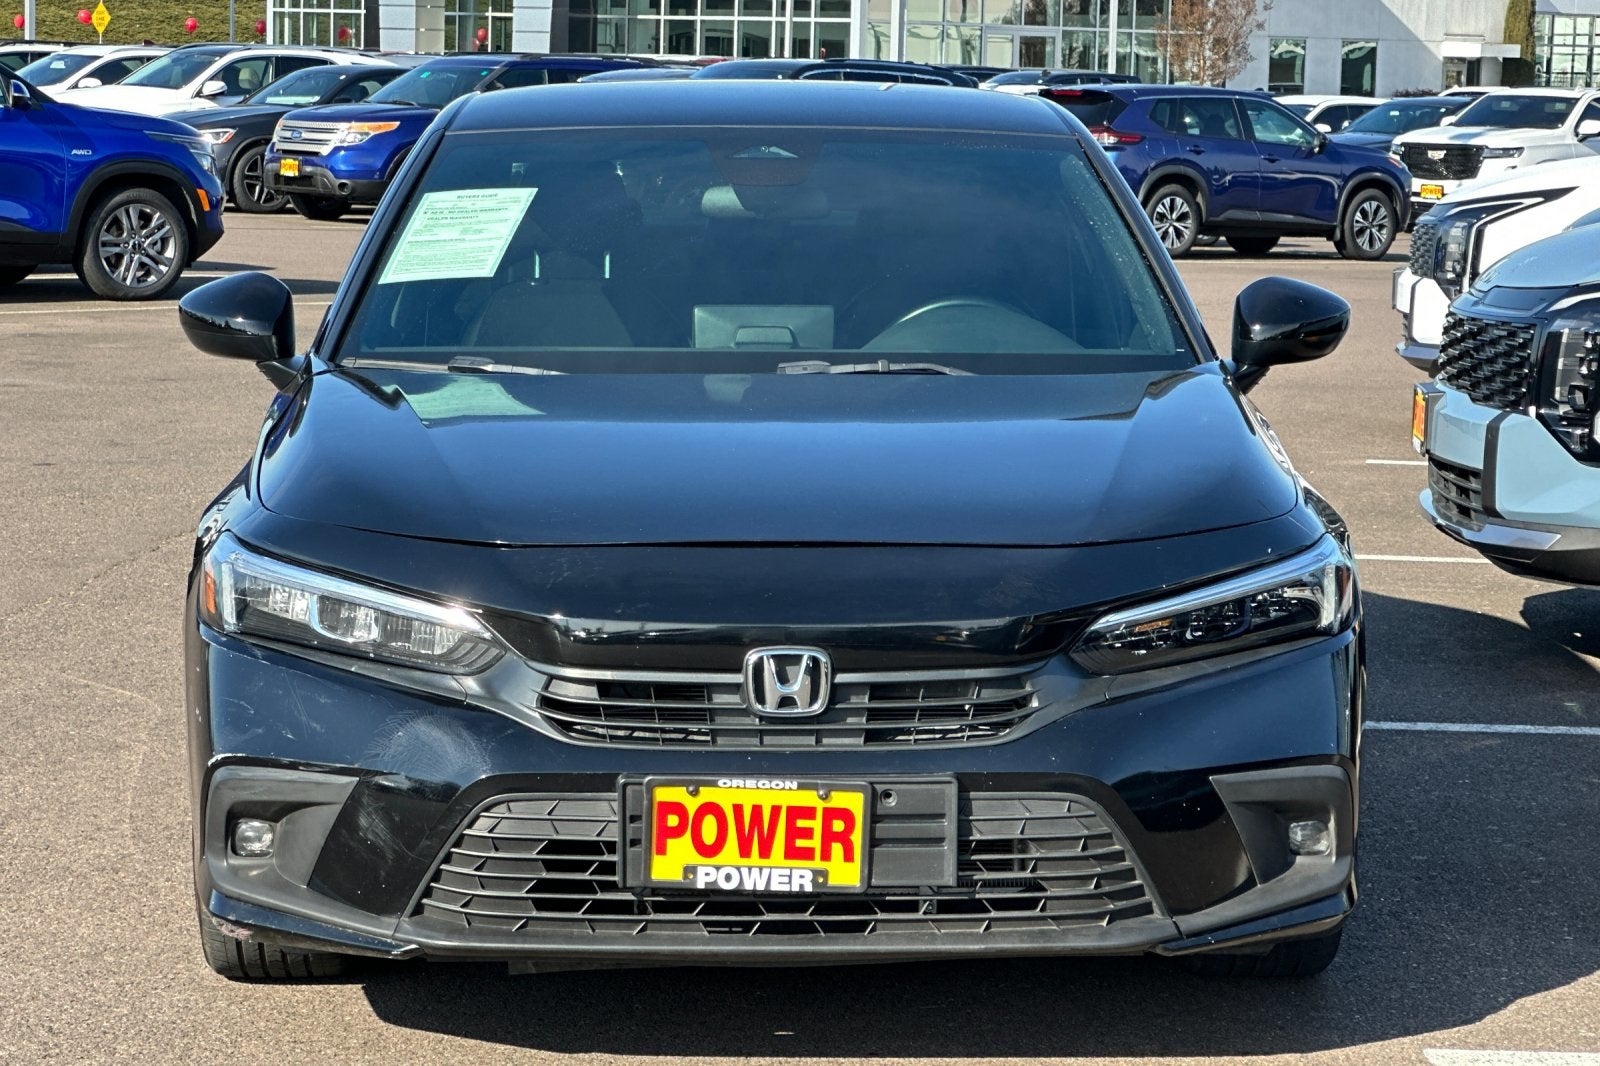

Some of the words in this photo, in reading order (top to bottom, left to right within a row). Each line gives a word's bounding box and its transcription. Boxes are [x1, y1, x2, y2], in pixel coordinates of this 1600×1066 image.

[1422, 187, 1442, 195] POWER
[717, 778, 798, 790] OREGON
[655, 800, 857, 863] POWER
[696, 865, 814, 892] POWER
